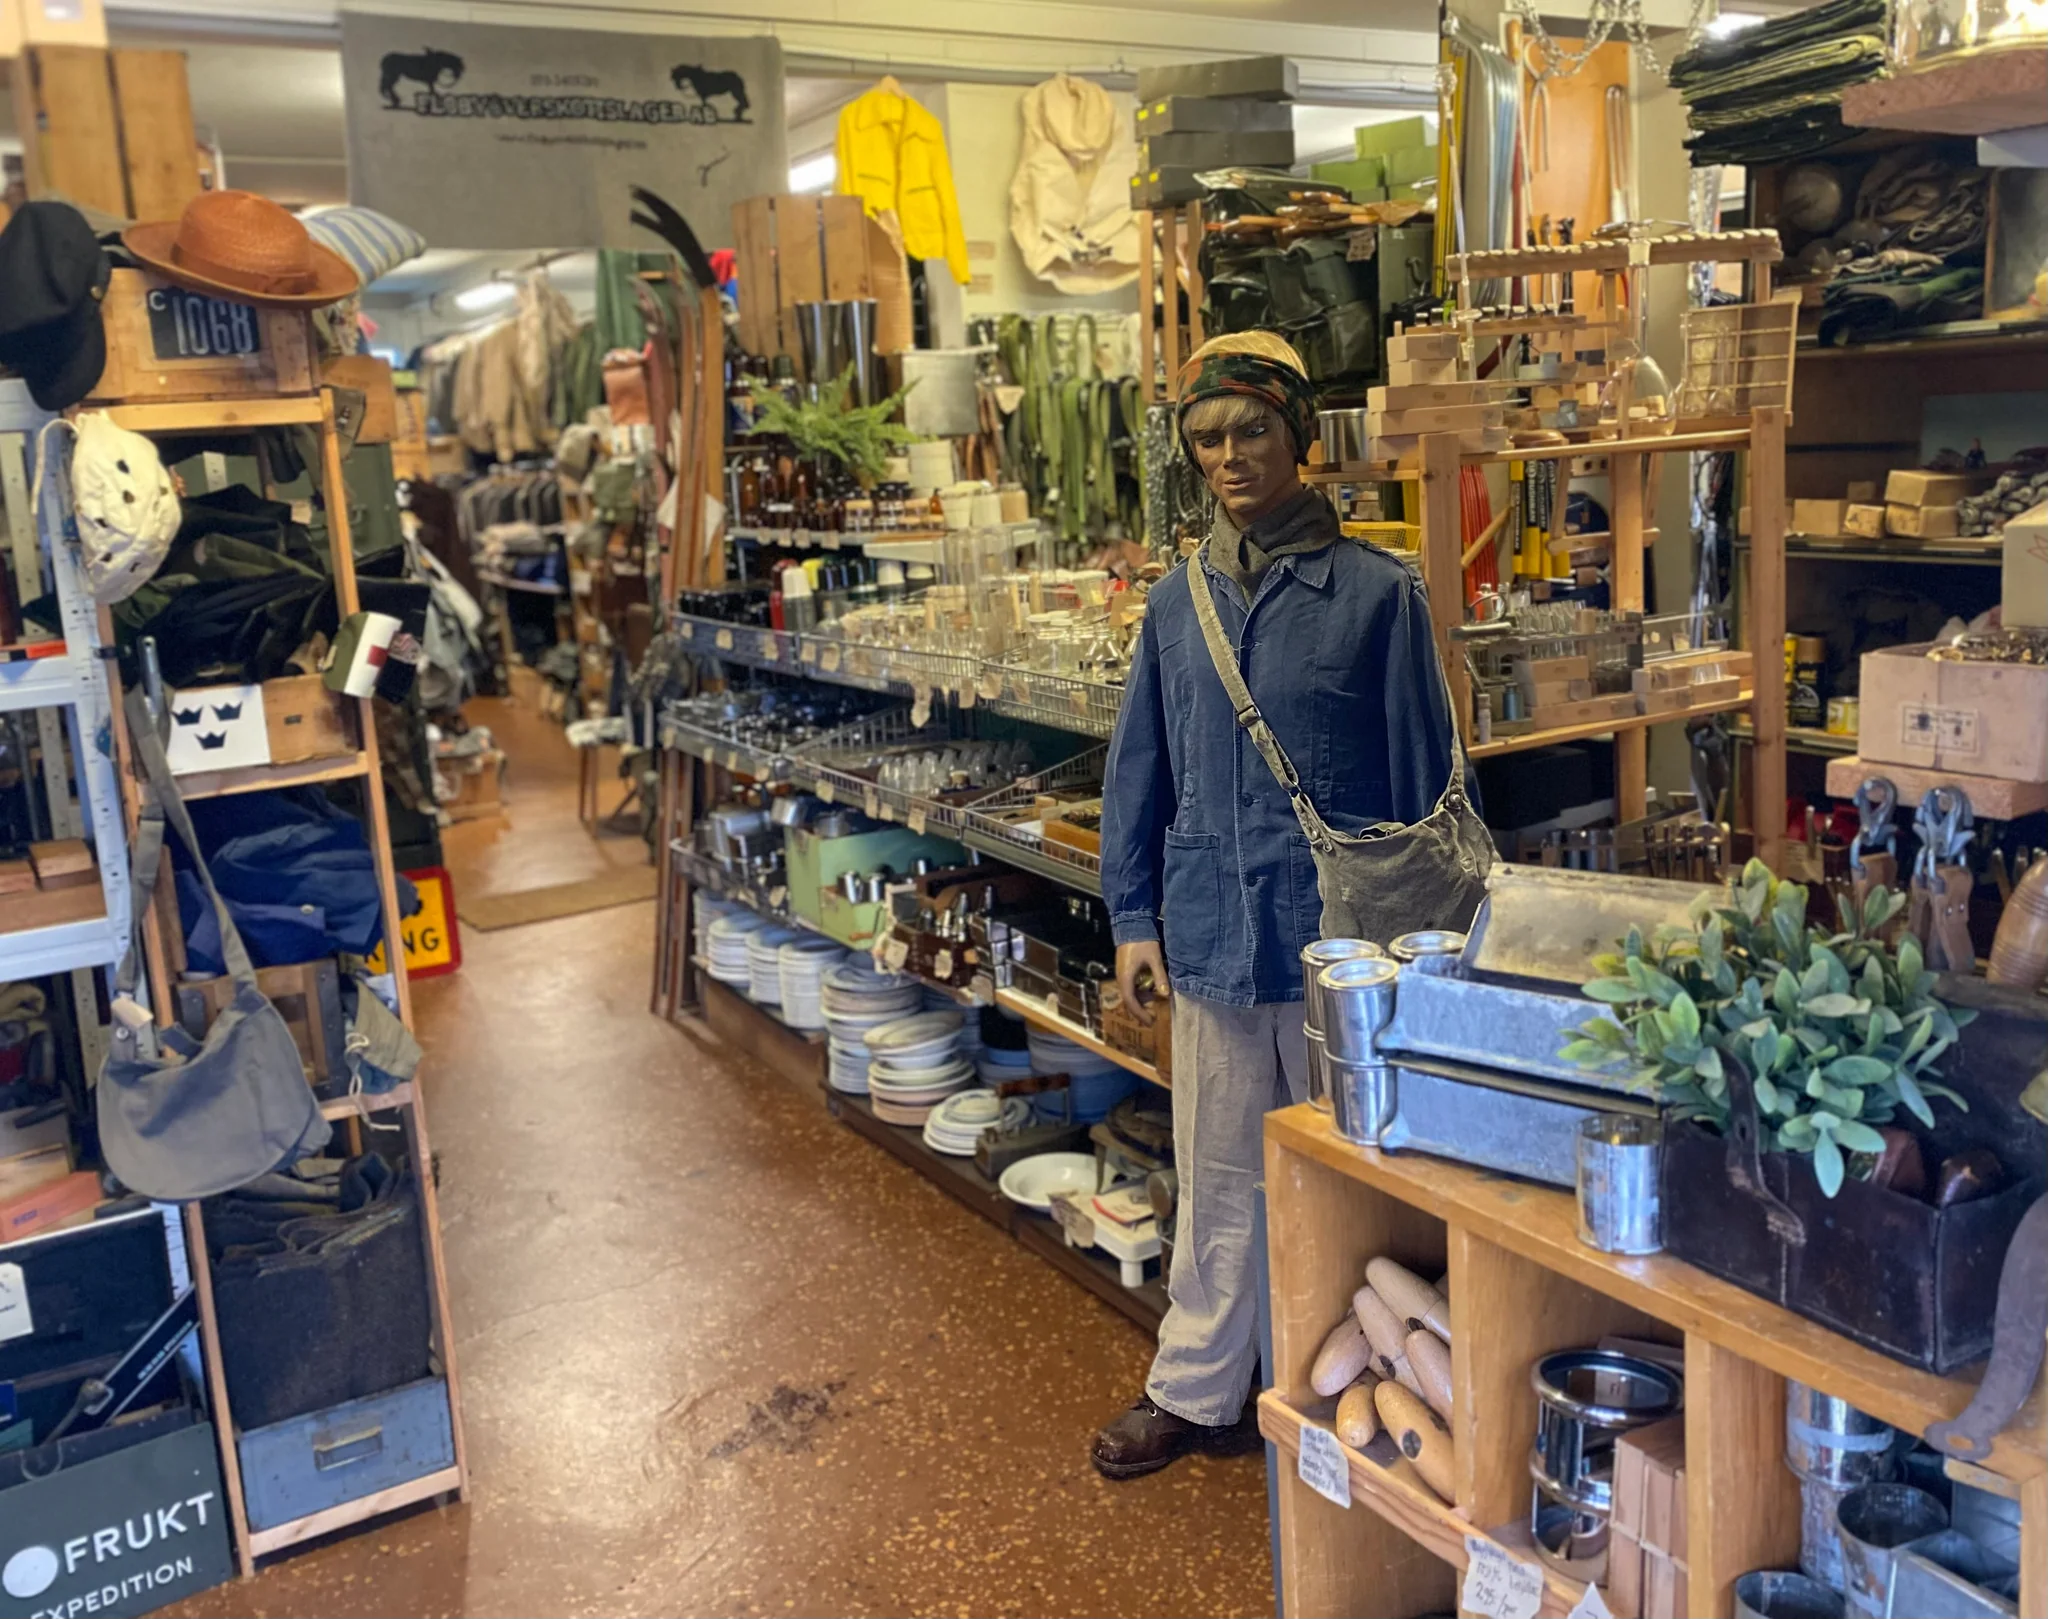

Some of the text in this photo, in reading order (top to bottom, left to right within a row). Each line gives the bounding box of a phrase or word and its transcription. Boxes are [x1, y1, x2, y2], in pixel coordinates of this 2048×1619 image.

[149, 291, 253, 355] C 1068
[1528, 479, 1536, 523] BUSHMAN
[64, 1490, 214, 1574] FRUKT
